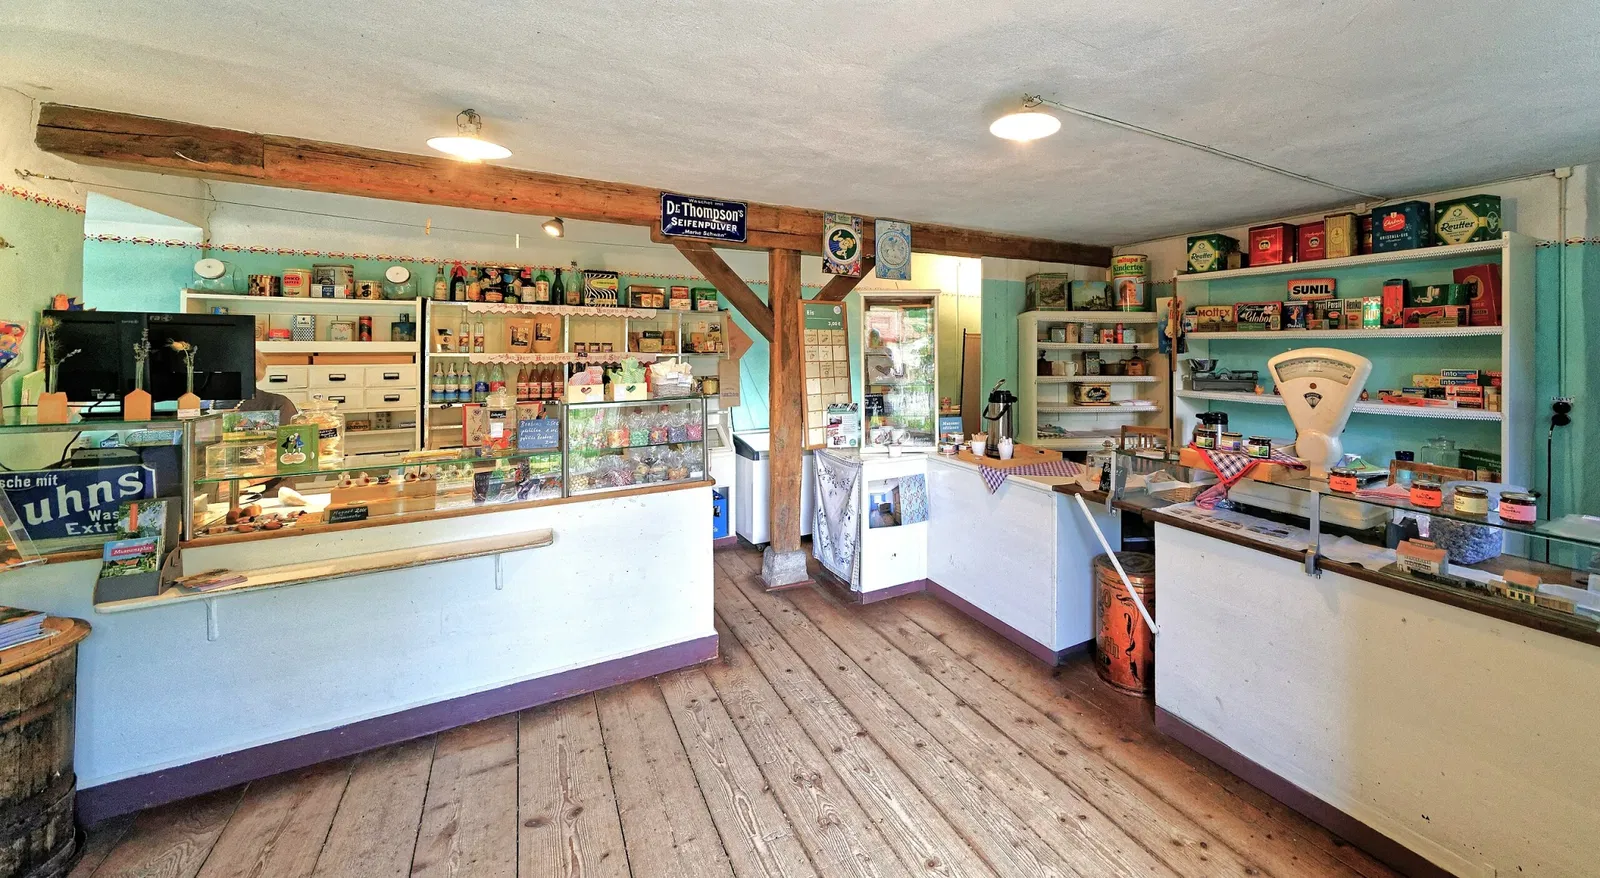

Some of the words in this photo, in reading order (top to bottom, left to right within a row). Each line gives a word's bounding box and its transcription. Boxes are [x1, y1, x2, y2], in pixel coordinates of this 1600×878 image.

[682, 202, 744, 222] Thompson's
[671, 217, 738, 232] SEIFENPULVER
[1440, 220, 1475, 232] Reutter
[1292, 285, 1330, 294] SUNIL
[36, 475, 58, 487] mit
[9, 471, 144, 531] uhns
